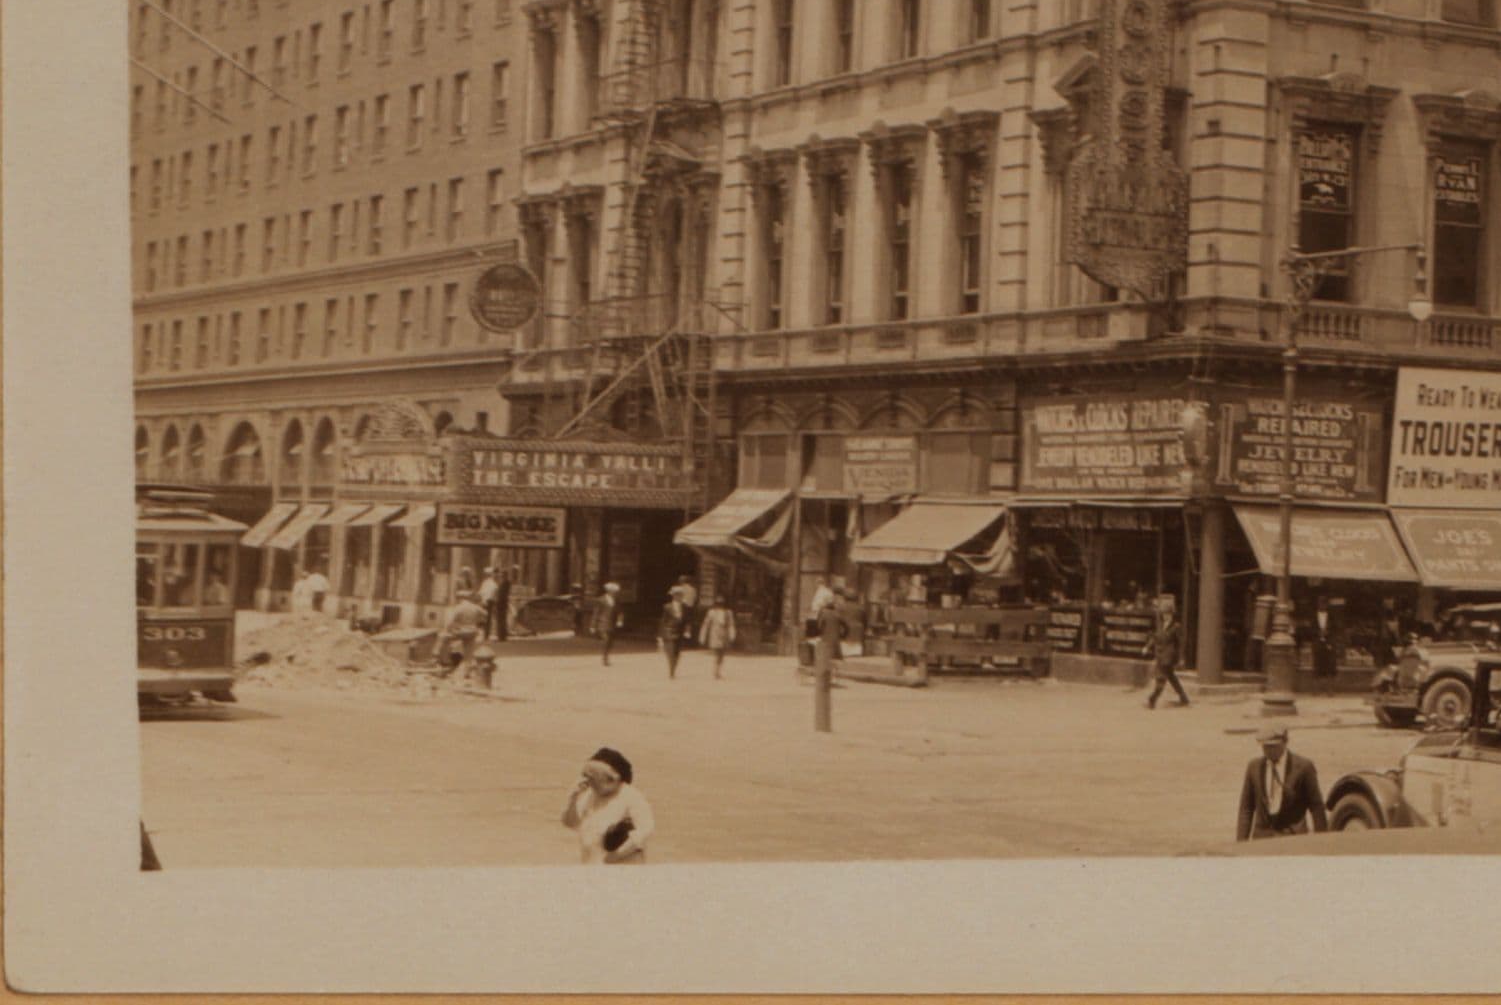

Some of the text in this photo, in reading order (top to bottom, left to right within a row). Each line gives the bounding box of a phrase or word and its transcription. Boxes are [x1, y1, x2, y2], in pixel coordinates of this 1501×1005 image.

[473, 451, 665, 471] VIRGINIA VALLI
[472, 470, 613, 489] THE ESCAPE
[444, 513, 481, 529] BIG
